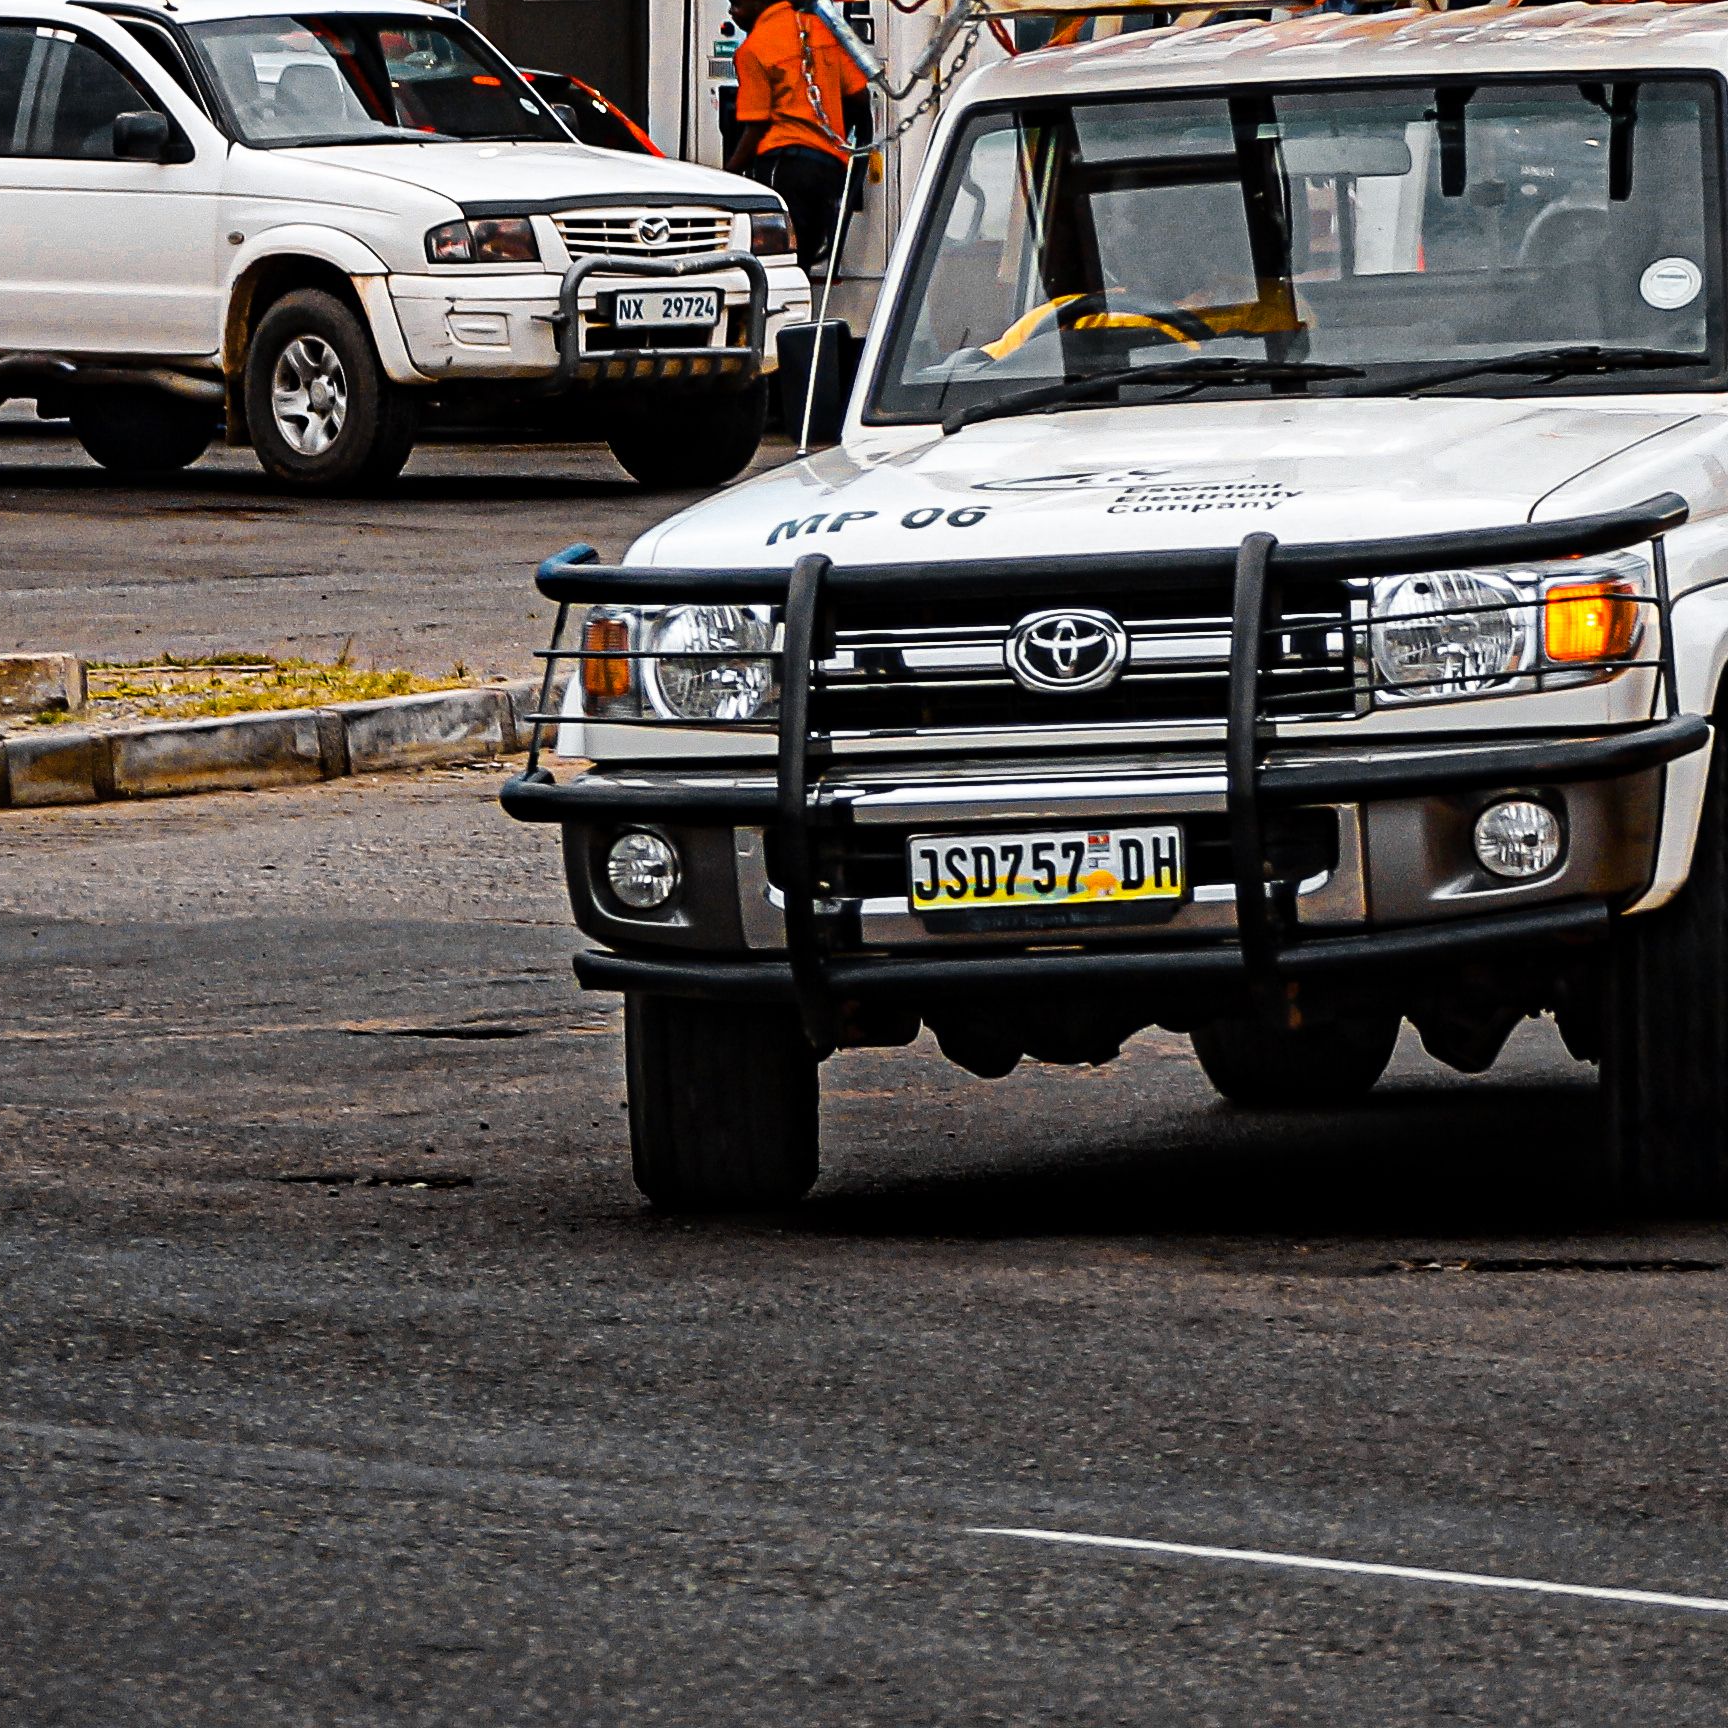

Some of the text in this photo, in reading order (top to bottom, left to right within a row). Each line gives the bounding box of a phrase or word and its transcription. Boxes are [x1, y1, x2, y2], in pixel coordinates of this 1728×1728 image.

[619, 296, 714, 320] NX 29724
[1107, 500, 1282, 514] Company
[1115, 490, 1304, 503] Electricity
[765, 505, 992, 547] MP 06
[1119, 835, 1178, 890] DH
